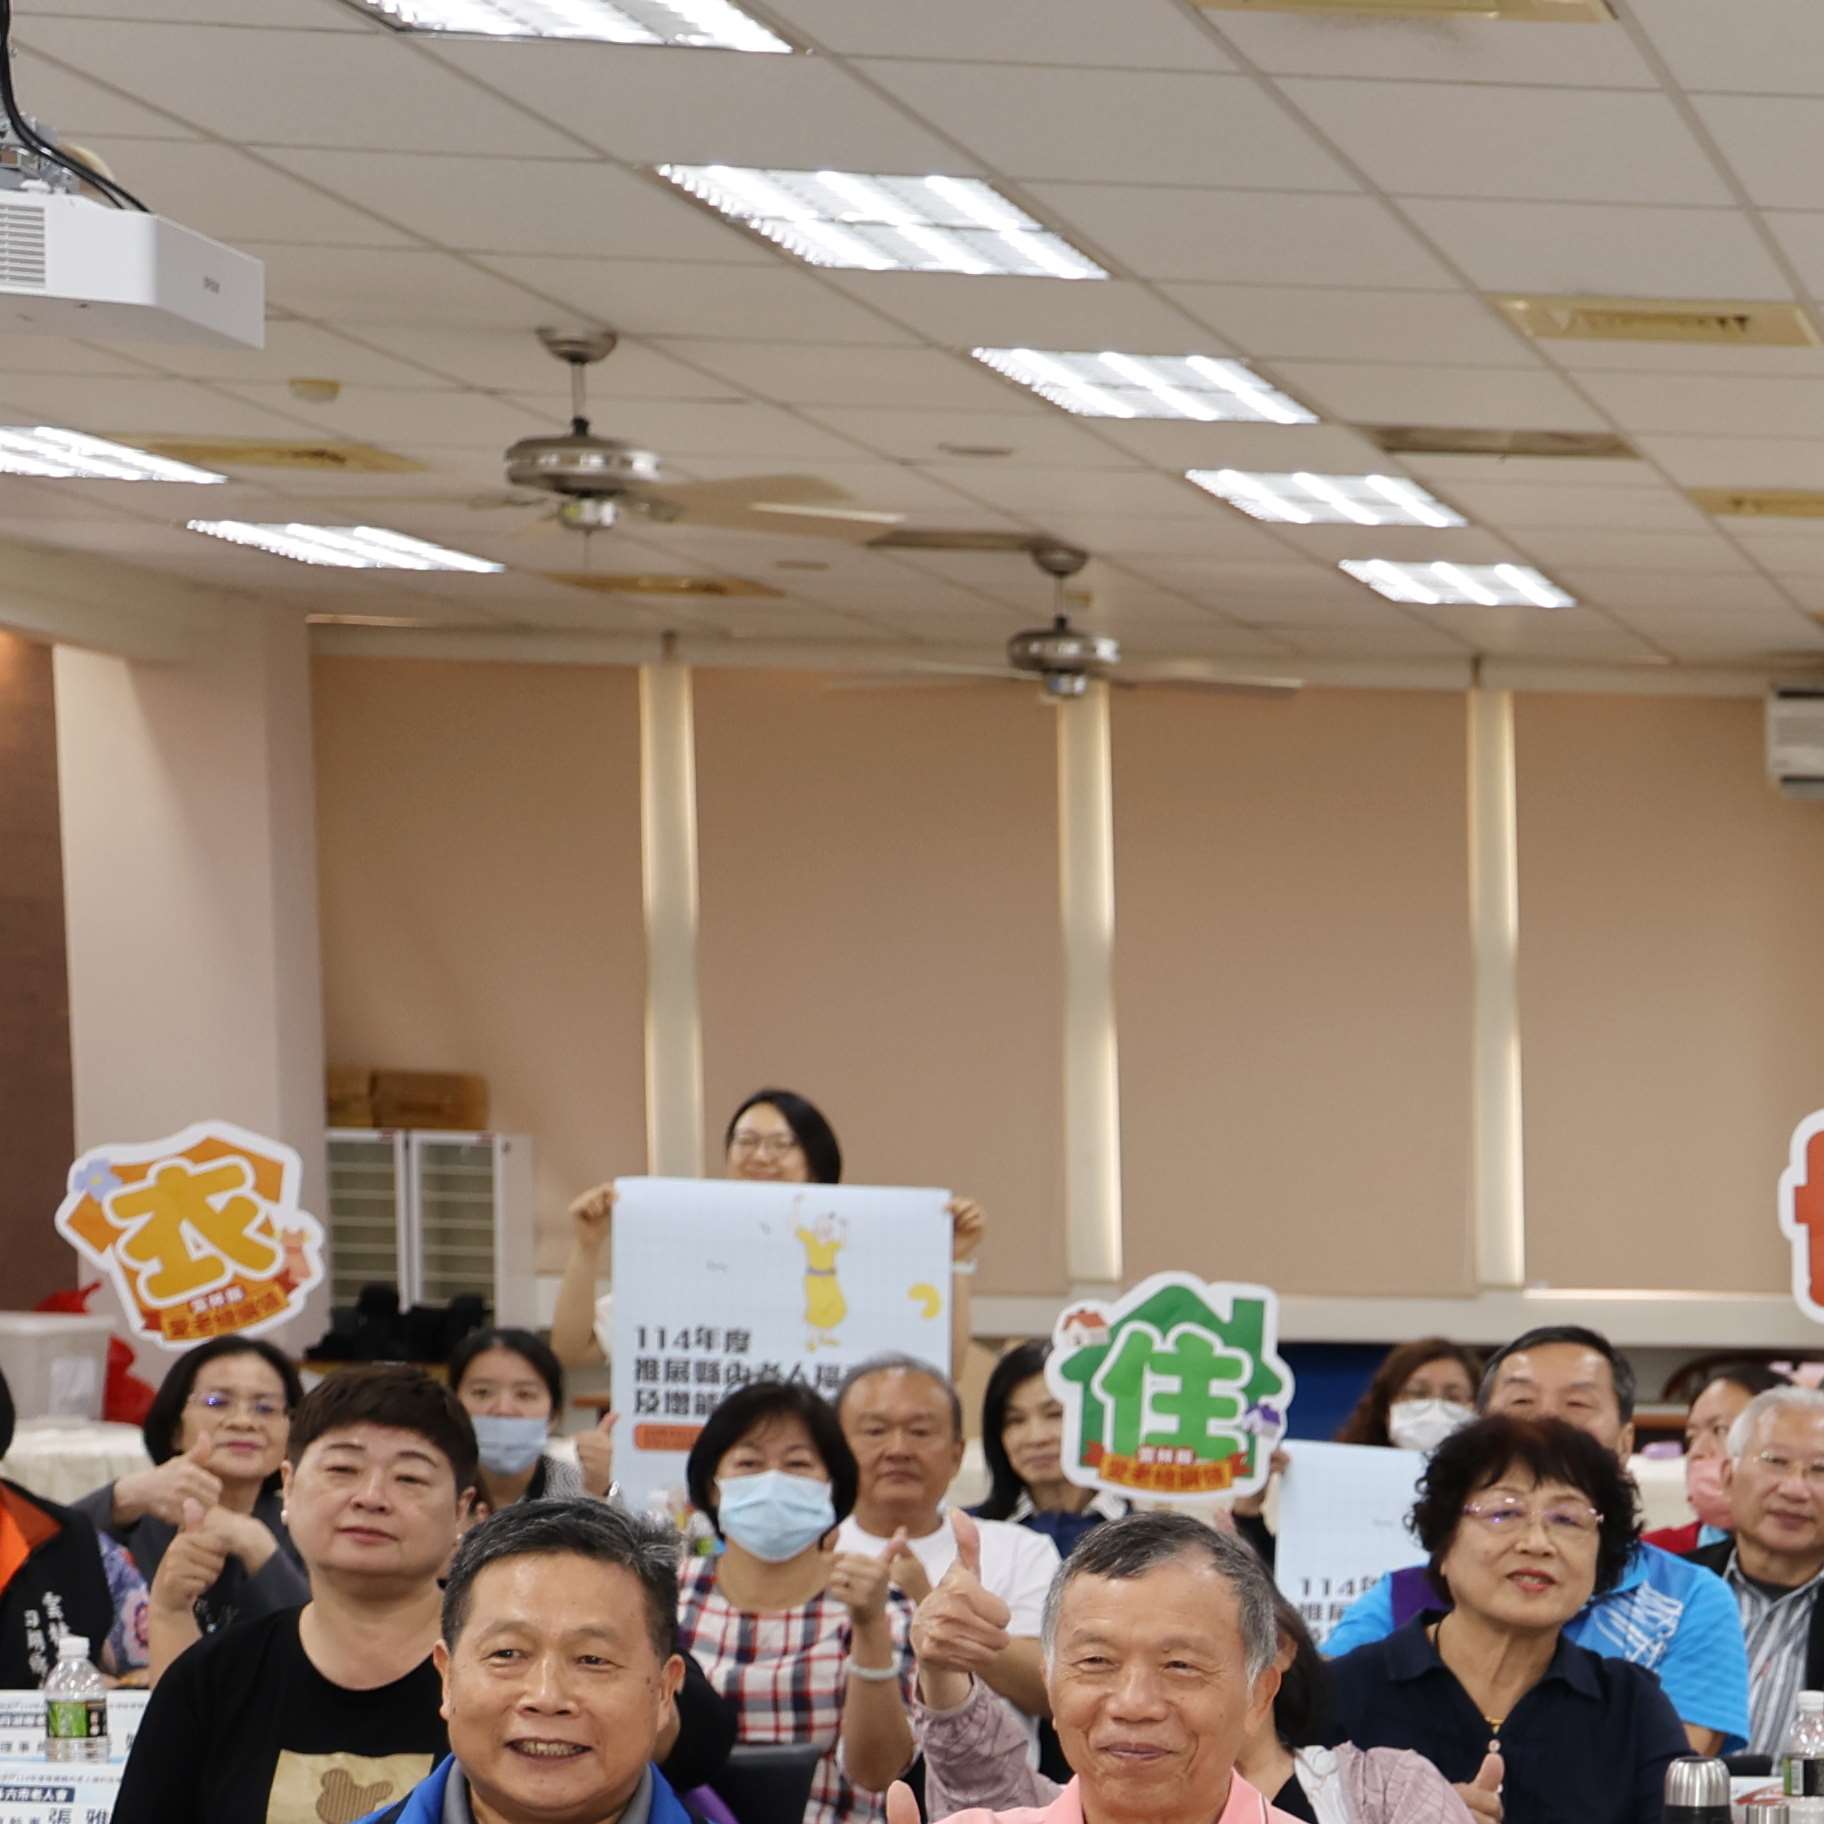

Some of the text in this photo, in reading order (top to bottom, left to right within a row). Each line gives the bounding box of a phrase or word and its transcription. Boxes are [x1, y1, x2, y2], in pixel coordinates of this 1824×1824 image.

[105, 1160, 282, 1303] 衣
[1102, 1328, 1247, 1457] 住
[0, 1786, 68, 1802] 六市老人會
